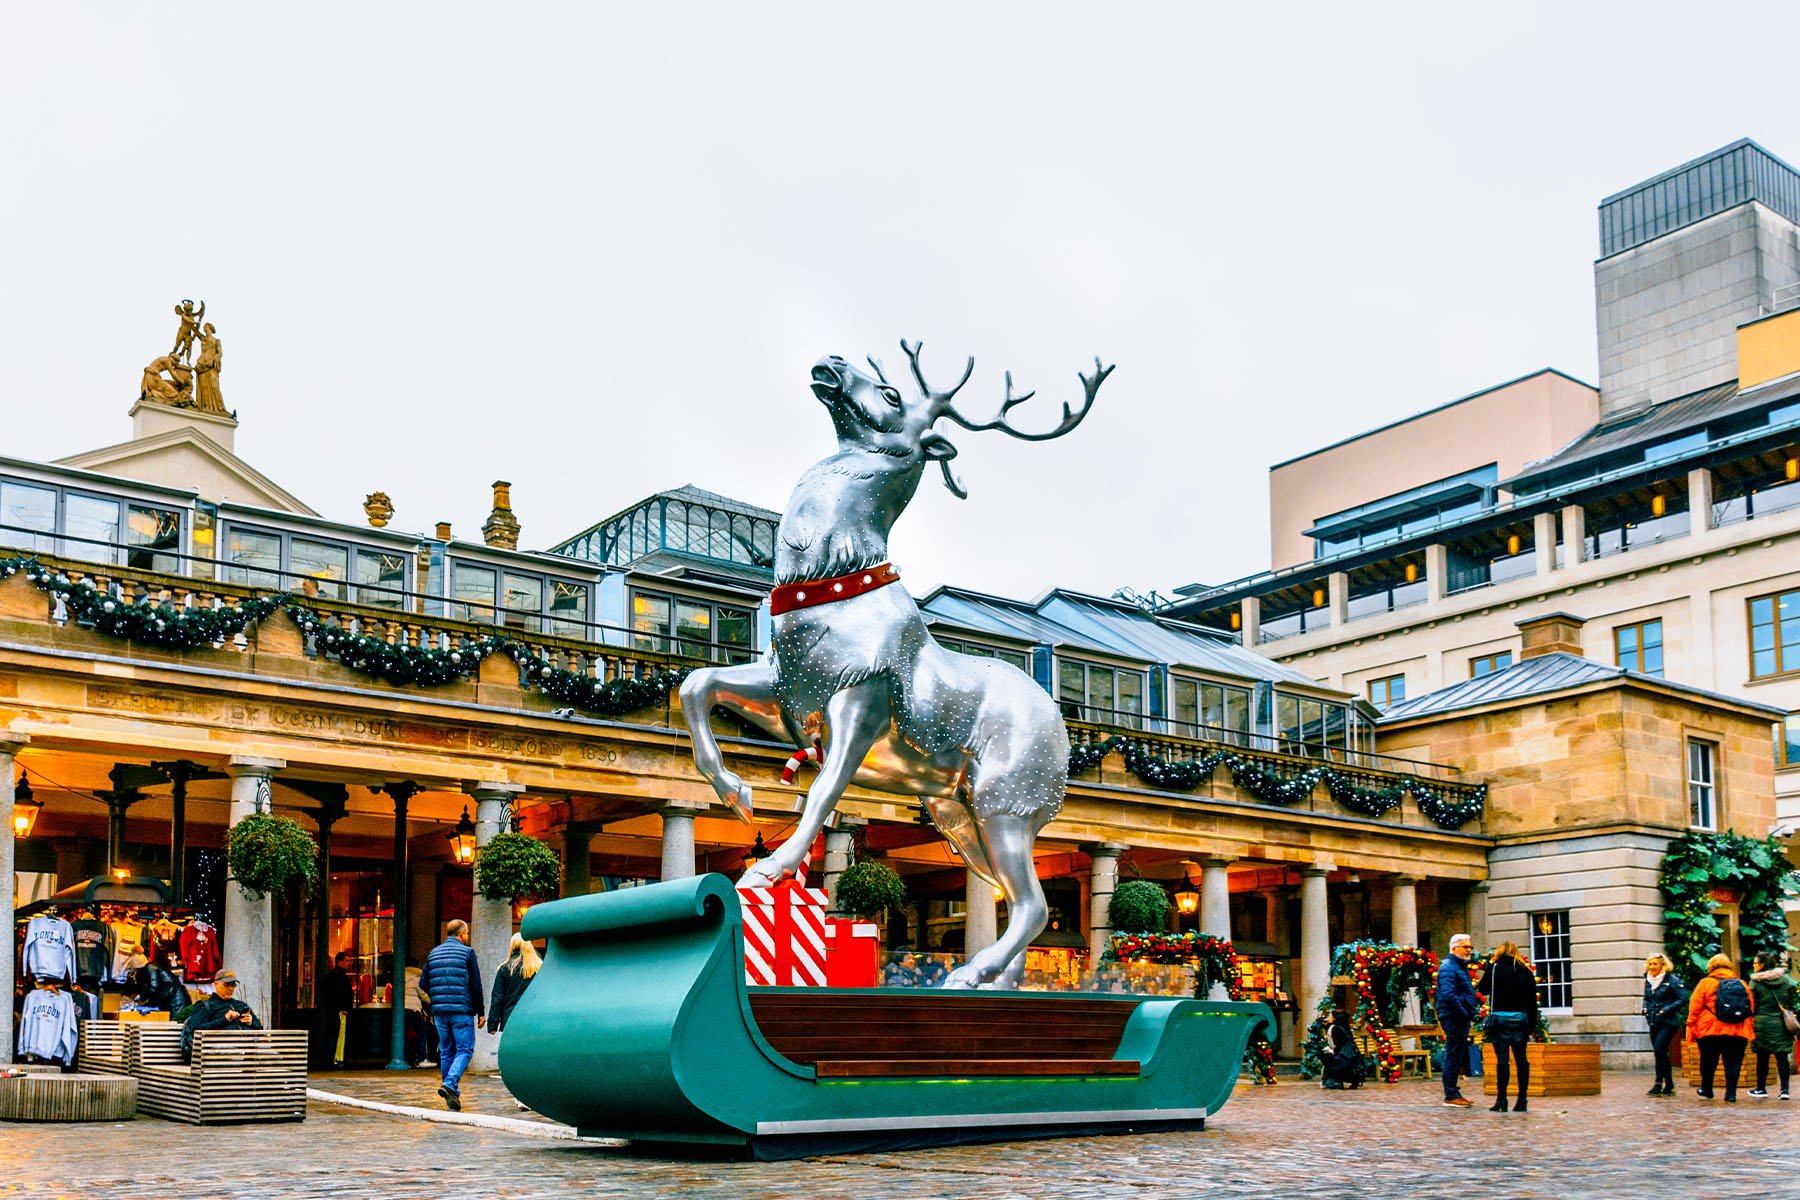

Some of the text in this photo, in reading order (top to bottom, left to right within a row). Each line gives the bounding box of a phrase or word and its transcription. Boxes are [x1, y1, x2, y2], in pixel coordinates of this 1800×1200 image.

[231, 704, 260, 724] BY
[273, 710, 335, 731] JOHN
[580, 742, 617, 763] 1830
[33, 1004, 60, 1019] LONDON
